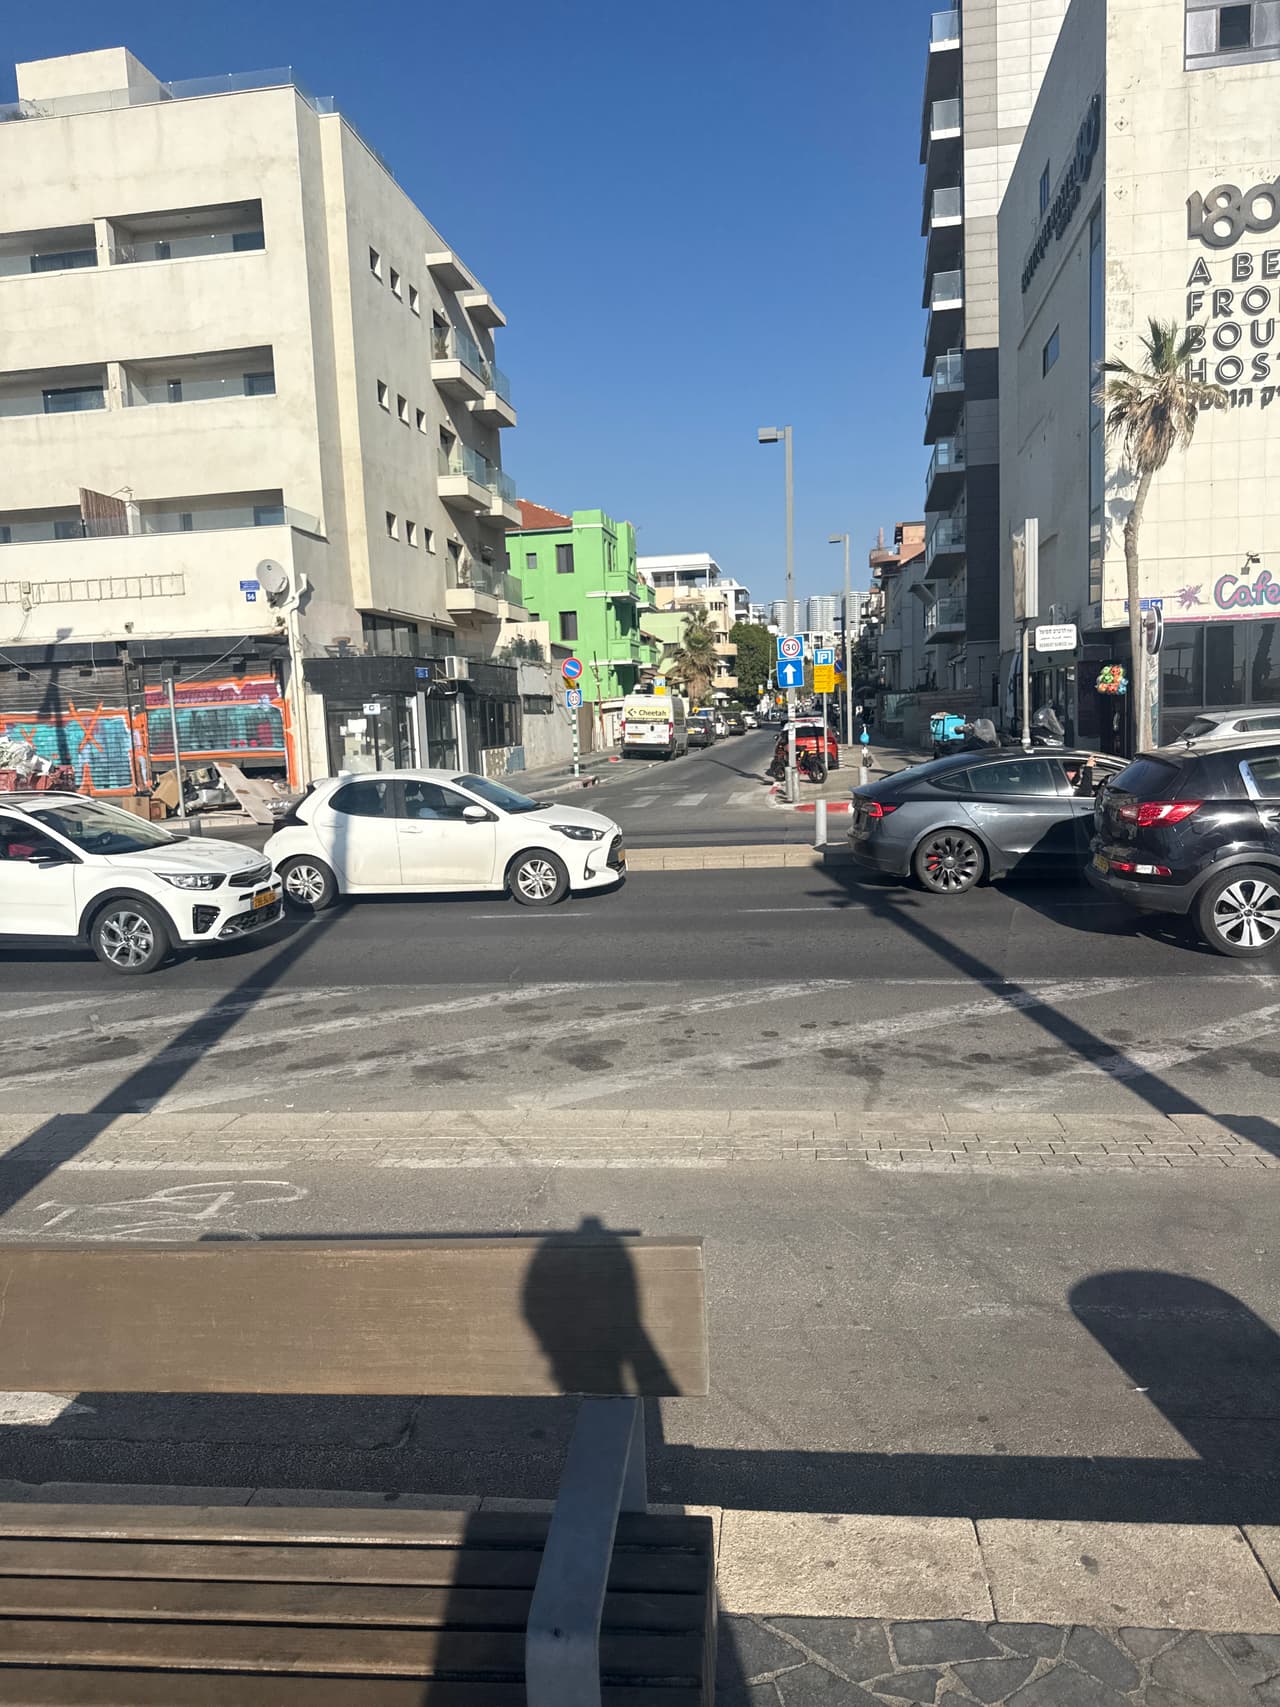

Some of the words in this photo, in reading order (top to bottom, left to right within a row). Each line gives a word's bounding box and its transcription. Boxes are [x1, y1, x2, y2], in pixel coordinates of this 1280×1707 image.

[1186, 257, 1212, 288] A
[1186, 285, 1280, 321] FRO
[1185, 317, 1275, 353] BOU
[1185, 352, 1280, 385] HOS
[785, 643, 797, 651] 30
[638, 709, 667, 718] Cheetah
